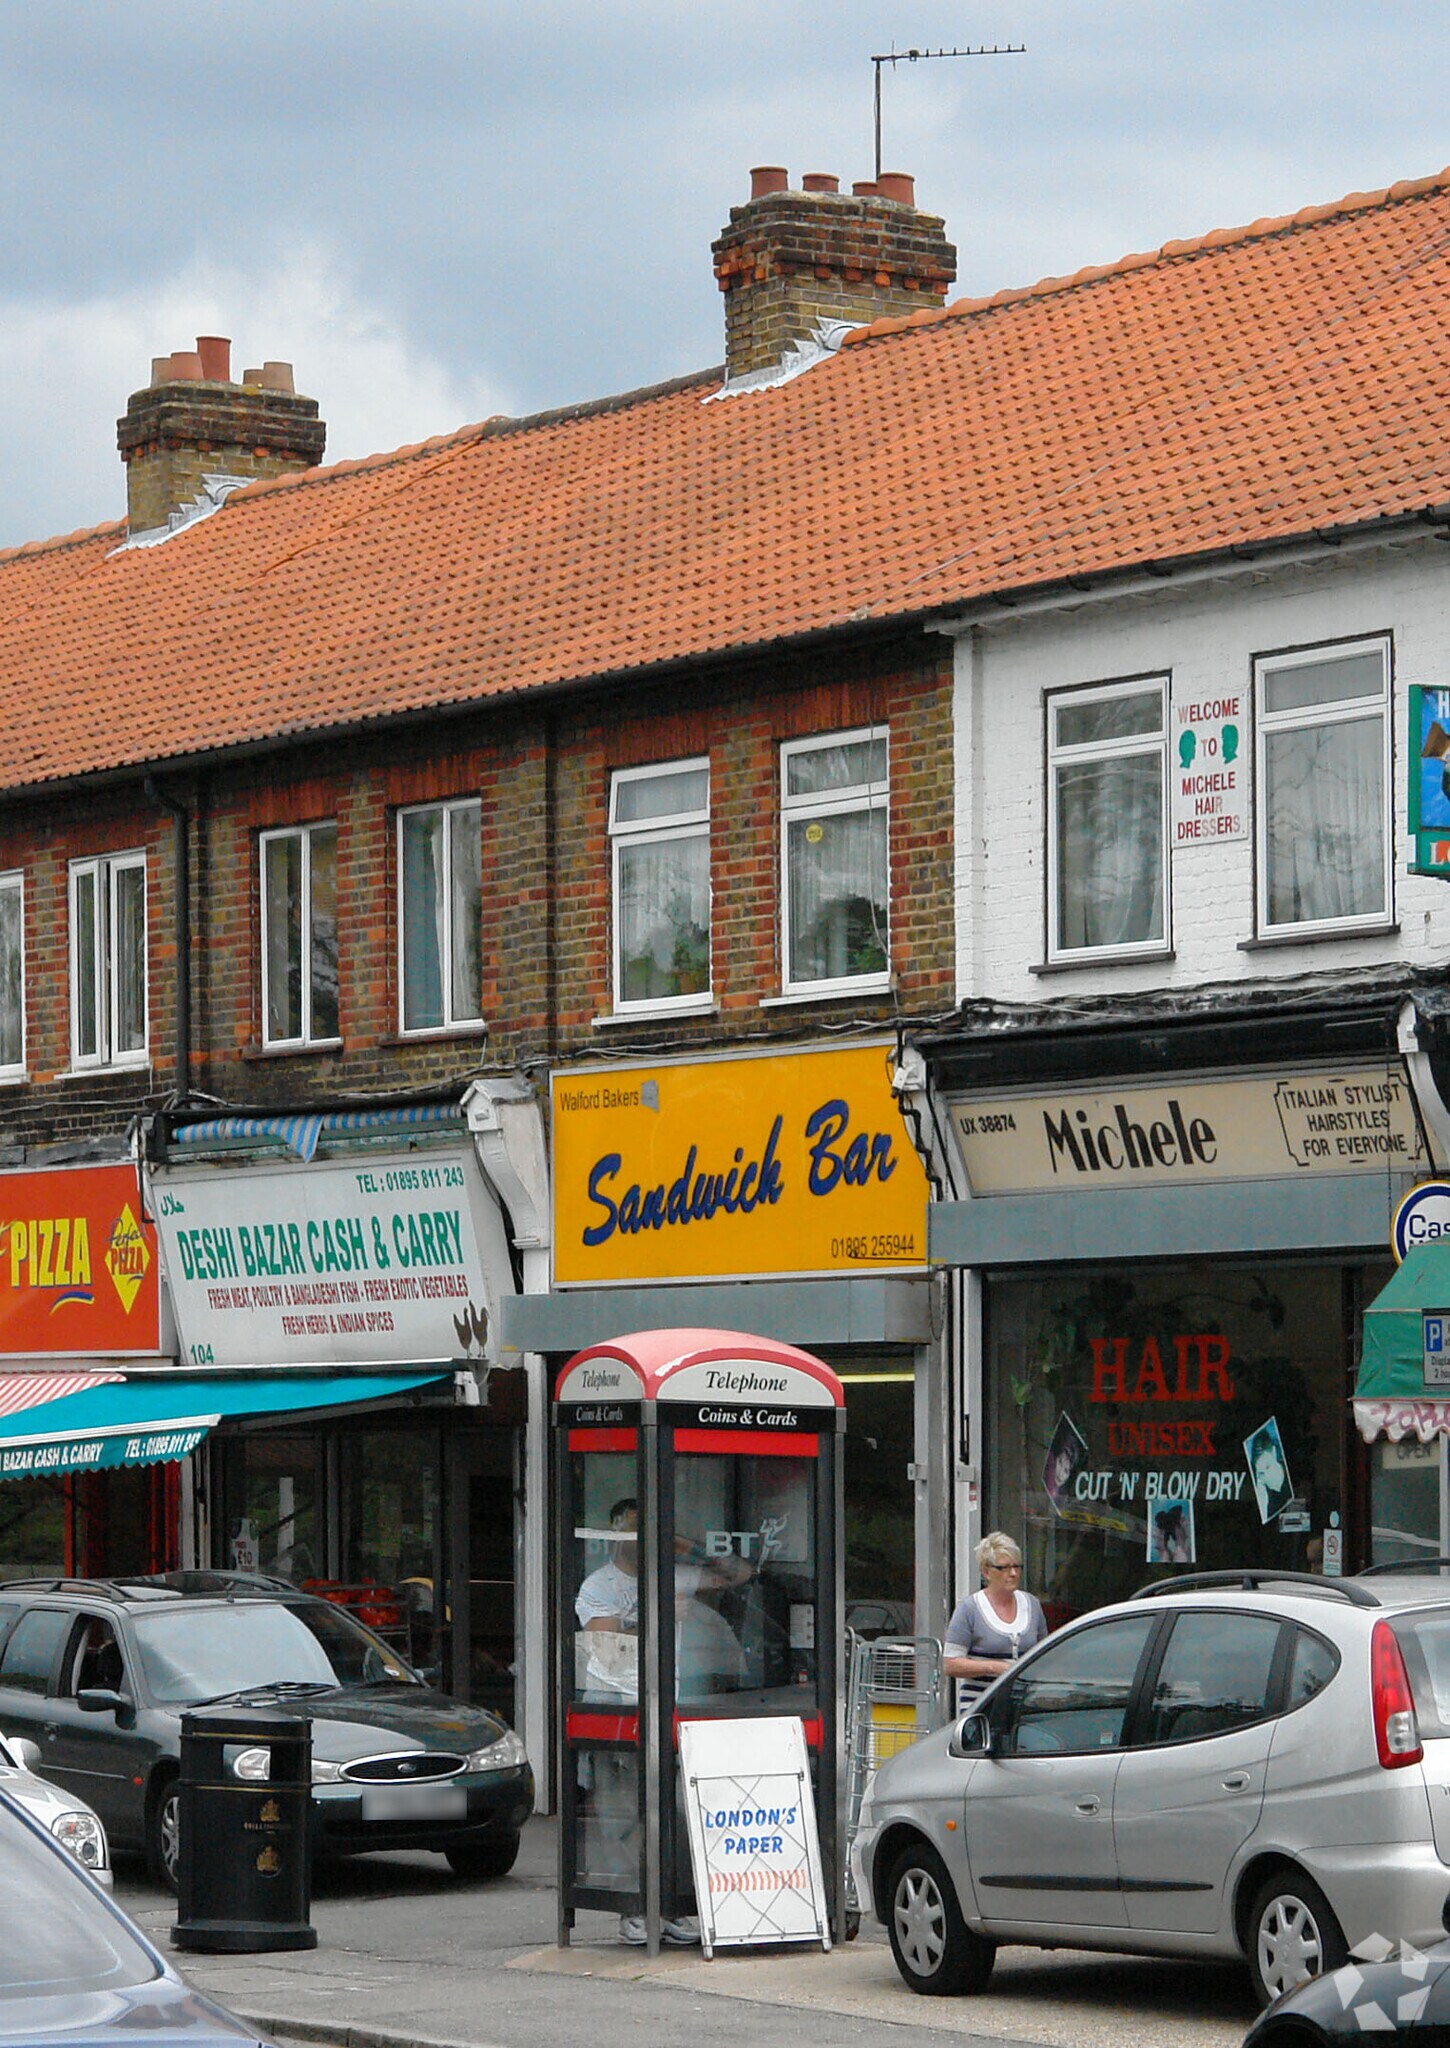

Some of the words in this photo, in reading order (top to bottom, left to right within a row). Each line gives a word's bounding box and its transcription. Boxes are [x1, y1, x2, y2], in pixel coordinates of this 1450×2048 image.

[1178, 698, 1239, 724] WELCOME
[1201, 737, 1217, 757] TO
[1182, 772, 1236, 796] MICHELE
[1195, 796, 1223, 816] HAIR
[1177, 814, 1240, 840] DRESSERS
[602, 1088, 639, 1108] Bakers
[1283, 1088, 1338, 1109] ITALIAN
[1344, 1083, 1400, 1105] STYLIST
[959, 1117, 979, 1135] UX
[978, 1113, 1017, 1134] 38874
[1307, 1110, 1390, 1132] HAIRSTYLES
[1043, 1100, 1217, 1173] Michele
[1303, 1138, 1331, 1157] FOR
[1336, 1134, 1407, 1156] EVERYONE
[386, 1170, 419, 1192] 01895
[421, 1168, 442, 1189] 811
[444, 1166, 464, 1187] 243
[583, 1115, 784, 1246] Sandwich
[805, 1099, 897, 1196] Bar
[10, 1217, 92, 1288] PIZZA
[177, 1227, 239, 1280] DESHI
[238, 1223, 306, 1276] BAZAR
[306, 1217, 369, 1274] CASH
[371, 1215, 390, 1269] &
[392, 1210, 464, 1268] CARRY
[831, 1236, 867, 1258] 01895
[871, 1233, 914, 1256] 255944
[111, 1247, 144, 1275] PIZZA
[207, 1287, 231, 1310] FRESH
[230, 1286, 254, 1312] MEAT,
[252, 1284, 284, 1308] POULTRY
[284, 1284, 291, 1306] &
[290, 1281, 340, 1306] BANGLADESHI
[339, 1280, 361, 1303] FISH
[363, 1279, 391, 1302] FRESH
[389, 1276, 419, 1300] EXOTIC
[418, 1274, 468, 1299] VEGETABLES
[281, 1315, 306, 1335] FRESH
[305, 1314, 329, 1335] HERBS
[329, 1314, 337, 1334] &
[336, 1312, 366, 1333] INDIAN
[365, 1310, 394, 1332] SPICES
[190, 1343, 214, 1364] 104
[582, 1369, 620, 1391] Telephone
[1088, 1334, 1235, 1402] HAIR
[706, 1370, 788, 1393] Telephone
[698, 1407, 737, 1423] Coins
[739, 1408, 753, 1425] &
[756, 1409, 798, 1426] Cards
[1108, 1420, 1217, 1457] UNISEX
[3, 1450, 34, 1471] BAZAR
[34, 1446, 60, 1468] CASH
[61, 1445, 69, 1464] &
[70, 1442, 104, 1464] CARRY
[1075, 1471, 1114, 1500] CUT
[1145, 1471, 1201, 1500] BLOW
[1206, 1471, 1246, 1500] DRY
[705, 1531, 759, 1558] BT
[705, 1806, 797, 1828] LONDON'S
[724, 1836, 783, 1855] PAPER
